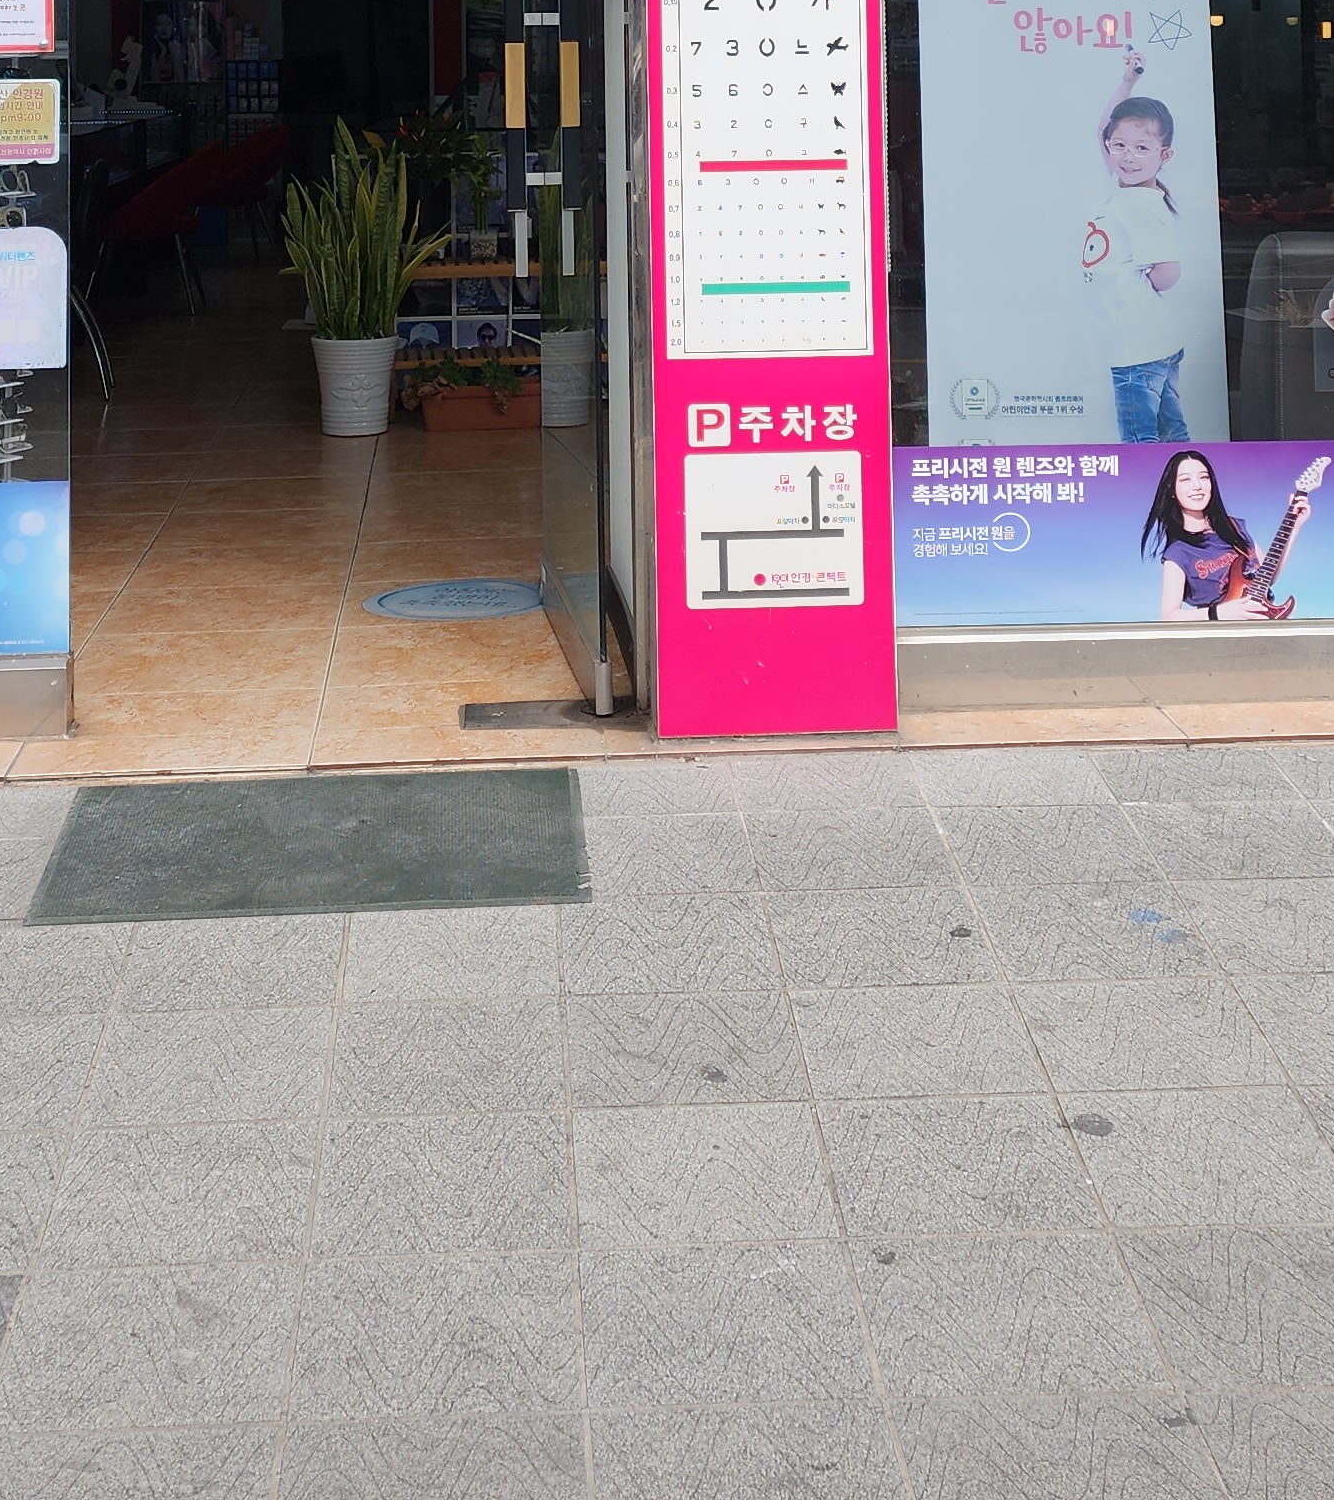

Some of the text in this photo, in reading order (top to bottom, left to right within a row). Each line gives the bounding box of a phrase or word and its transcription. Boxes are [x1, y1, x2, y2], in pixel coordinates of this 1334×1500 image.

[1014, 7, 1133, 54] 않아요!
[691, 39, 740, 57] 7 3
[12, 88, 44, 100] 안경원
[691, 84, 739, 97] 5 6
[26, 101, 44, 110] 안내
[1069, 405, 1084, 414] 수상
[738, 404, 857, 443] 주차장
[911, 455, 1119, 478] 프리시전 원 렌즈와 함께
[773, 485, 796, 493] 주차장
[828, 483, 850, 491] 주차장
[911, 482, 1085, 505] 촉촉하게 시작해 봐!
[913, 526, 1015, 541] 지금 프리시전 원을
[913, 542, 988, 557] 경험해 보세요!
